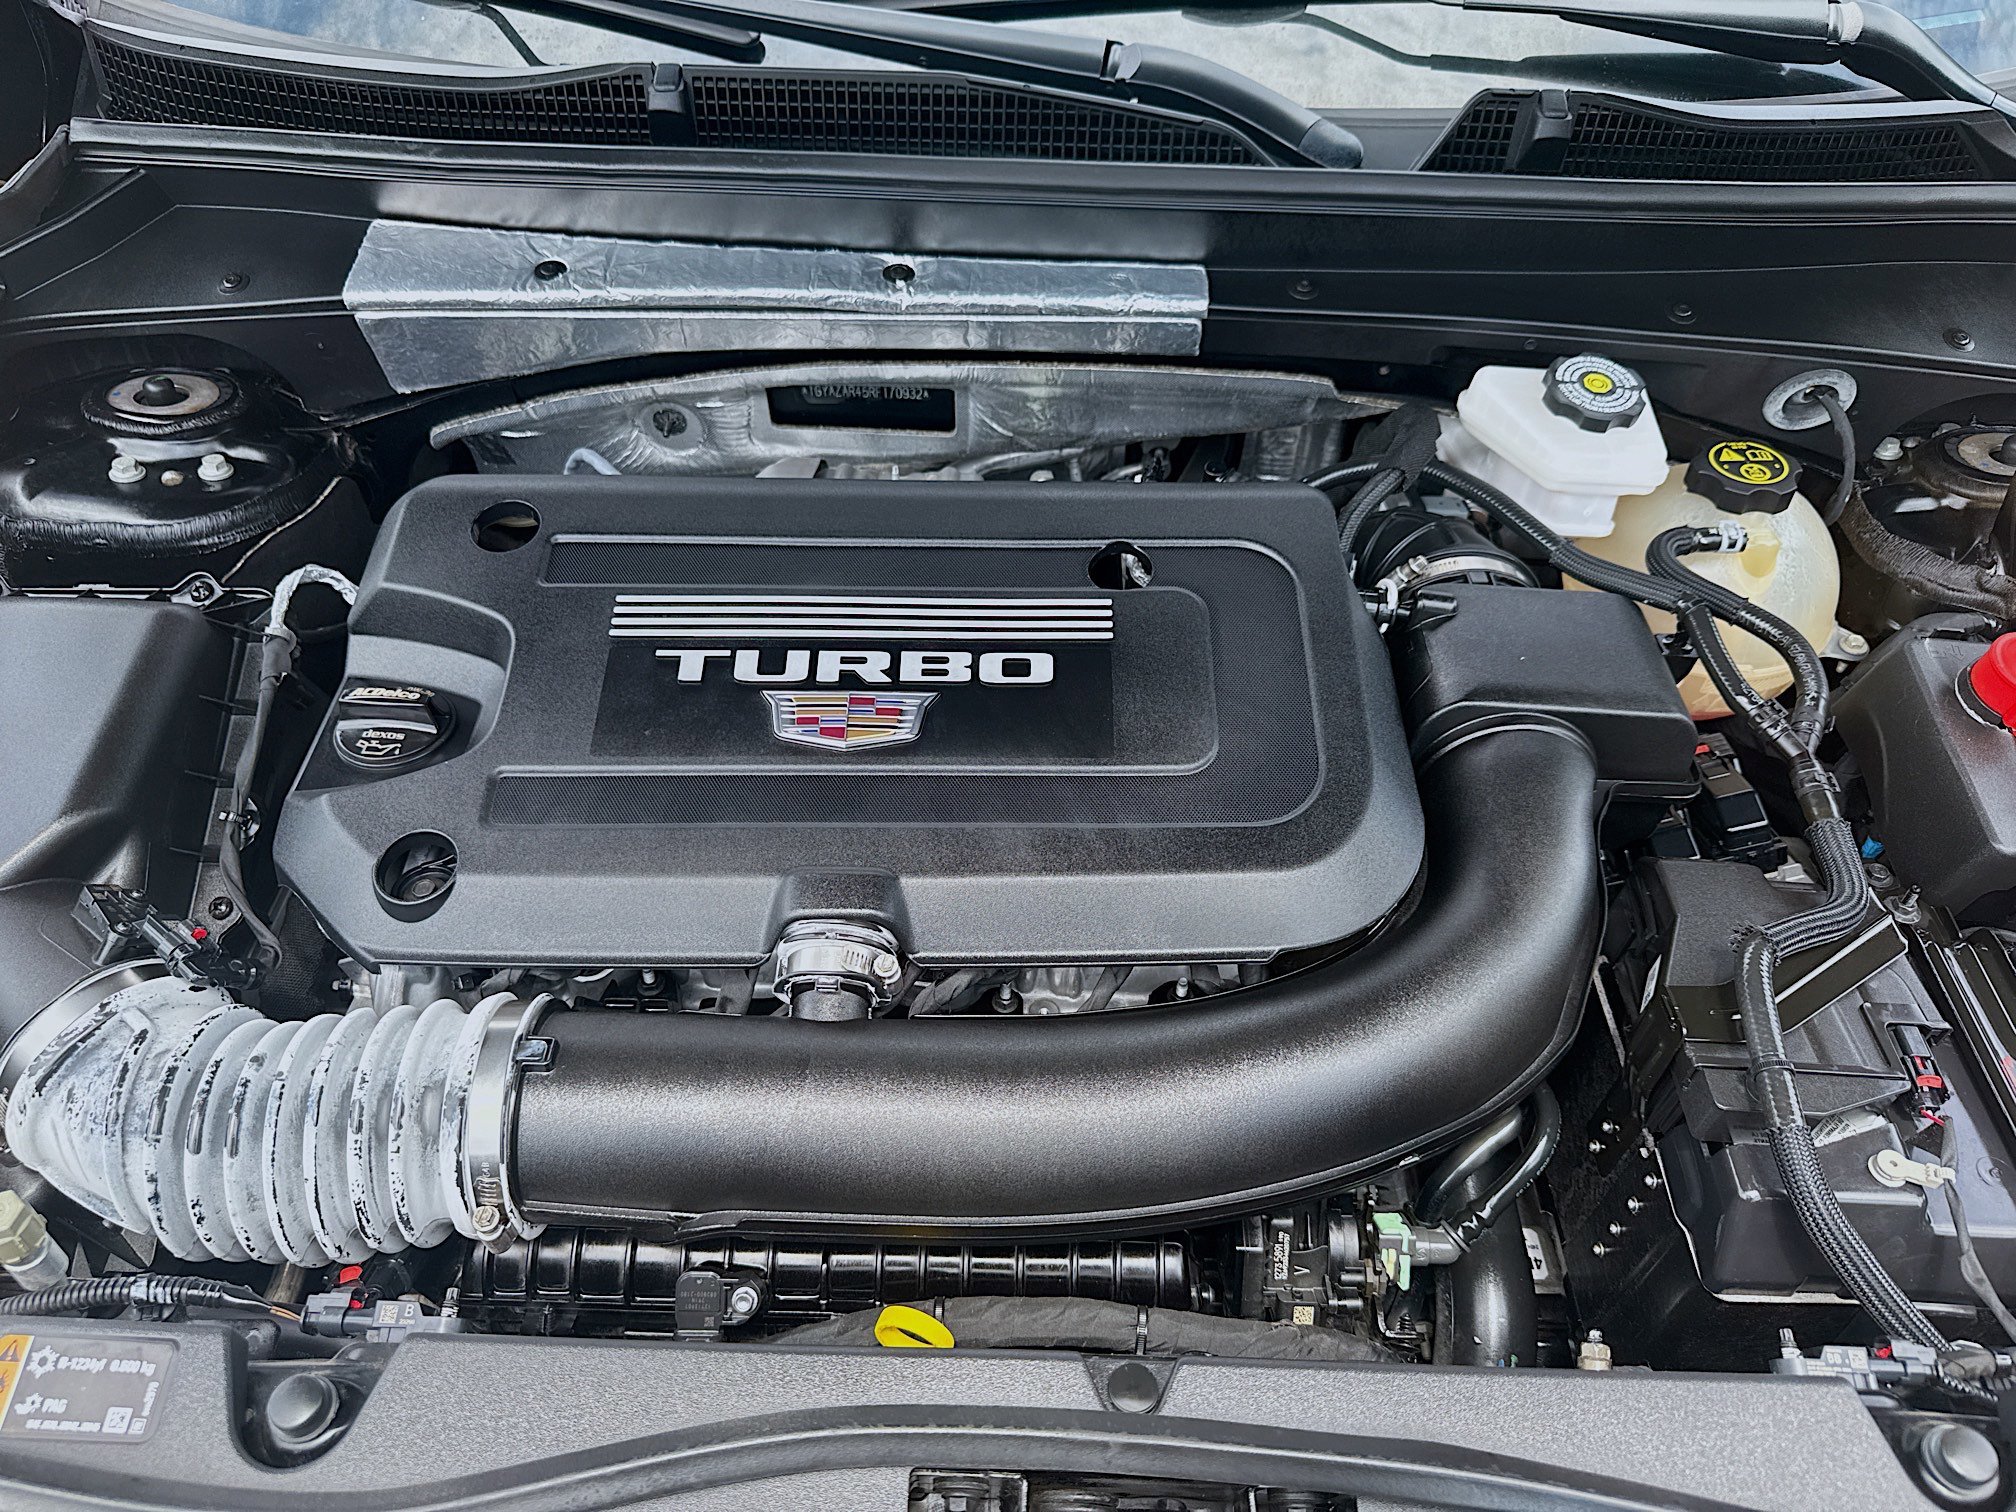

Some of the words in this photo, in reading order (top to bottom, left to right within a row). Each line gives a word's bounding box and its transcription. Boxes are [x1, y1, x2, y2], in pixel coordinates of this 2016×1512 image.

[655, 649, 1054, 684] TURBO
[348, 687, 421, 699] ACDelco
[362, 729, 405, 740] dexos
[404, 1304, 415, 1316] B
